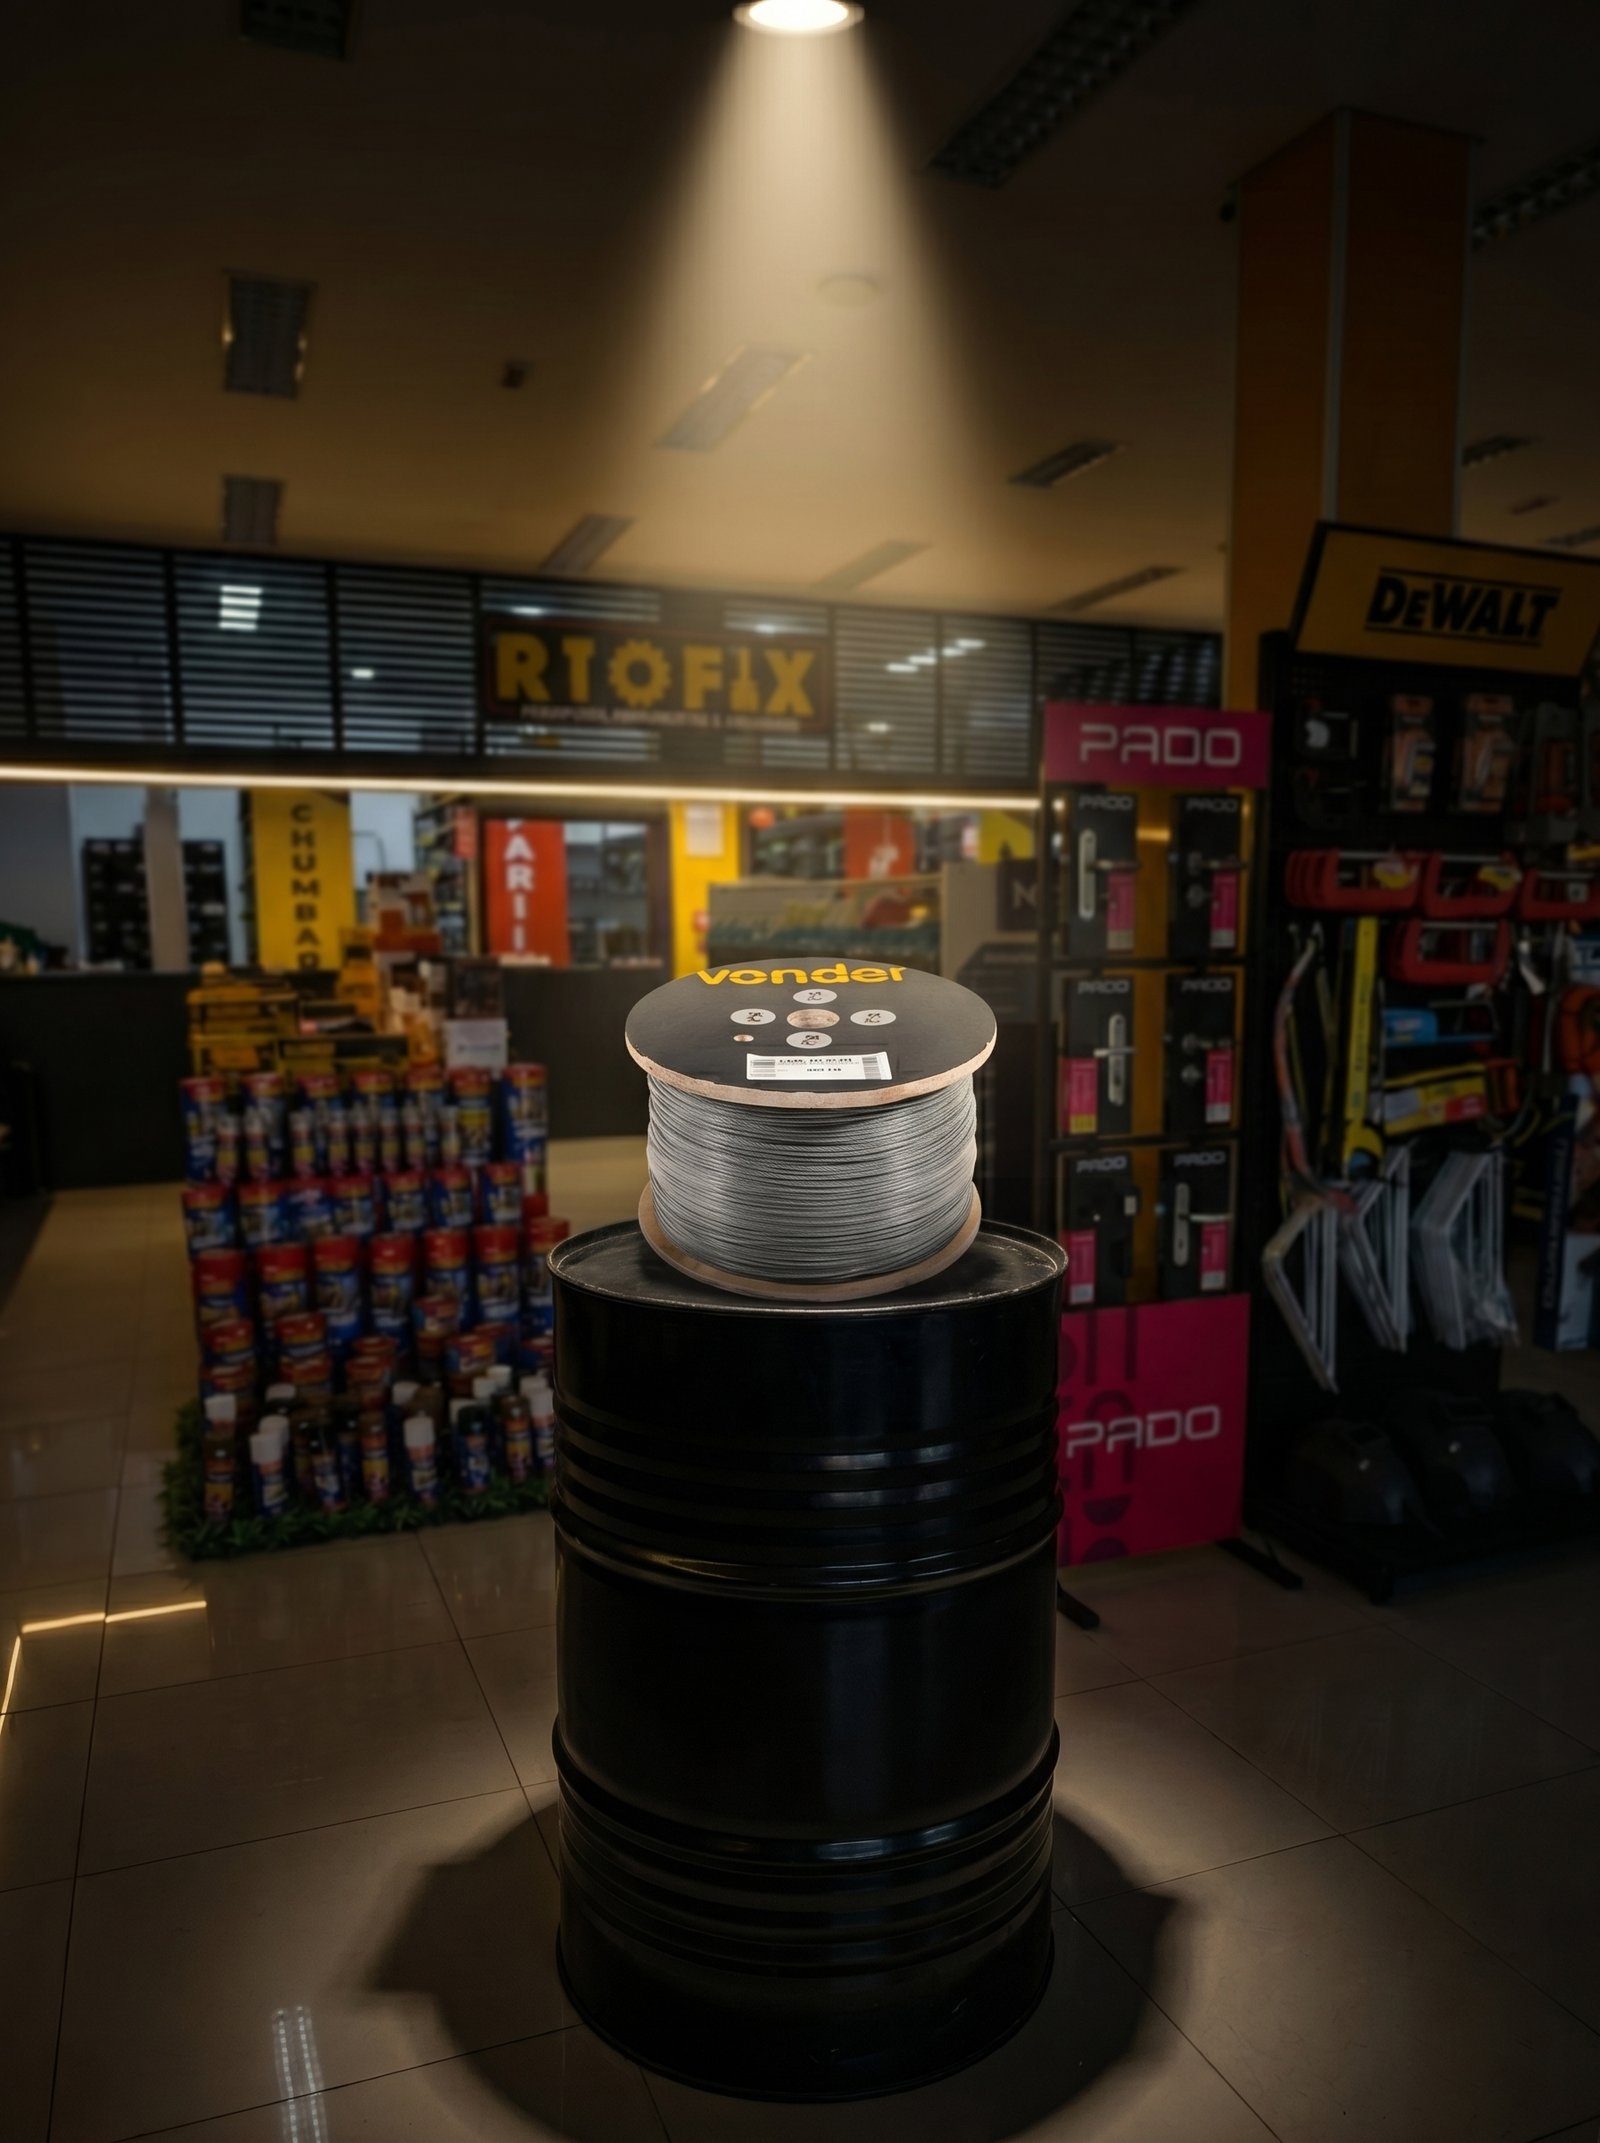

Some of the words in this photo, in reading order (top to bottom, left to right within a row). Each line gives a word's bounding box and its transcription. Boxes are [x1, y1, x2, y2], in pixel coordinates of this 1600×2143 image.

[1079, 722, 1242, 767] PADO
[1078, 795, 1134, 811] PADO
[697, 962, 908, 986] vonder
[1065, 1404, 1222, 1460] PADO
